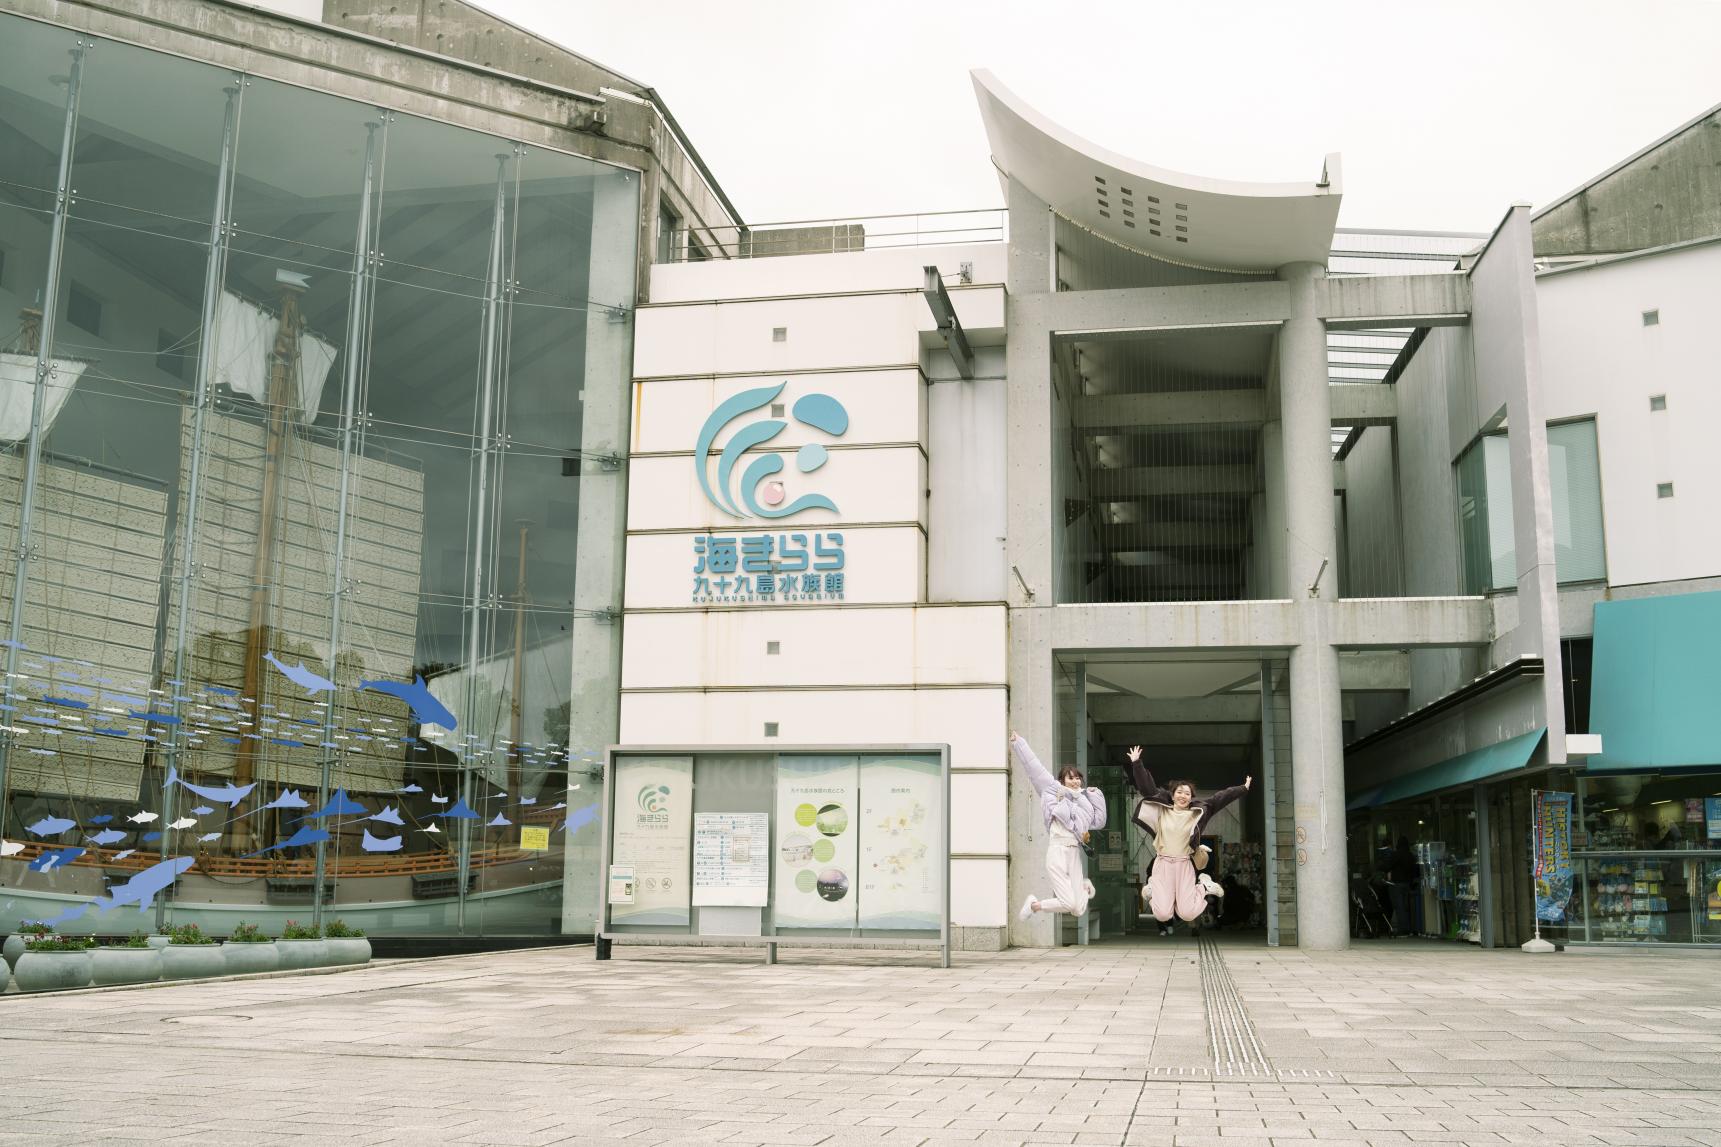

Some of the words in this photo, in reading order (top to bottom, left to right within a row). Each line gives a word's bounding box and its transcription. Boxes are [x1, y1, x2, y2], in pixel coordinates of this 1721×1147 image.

[694, 533, 845, 574] 海きらら
[692, 573, 845, 595] 九十九島水族館
